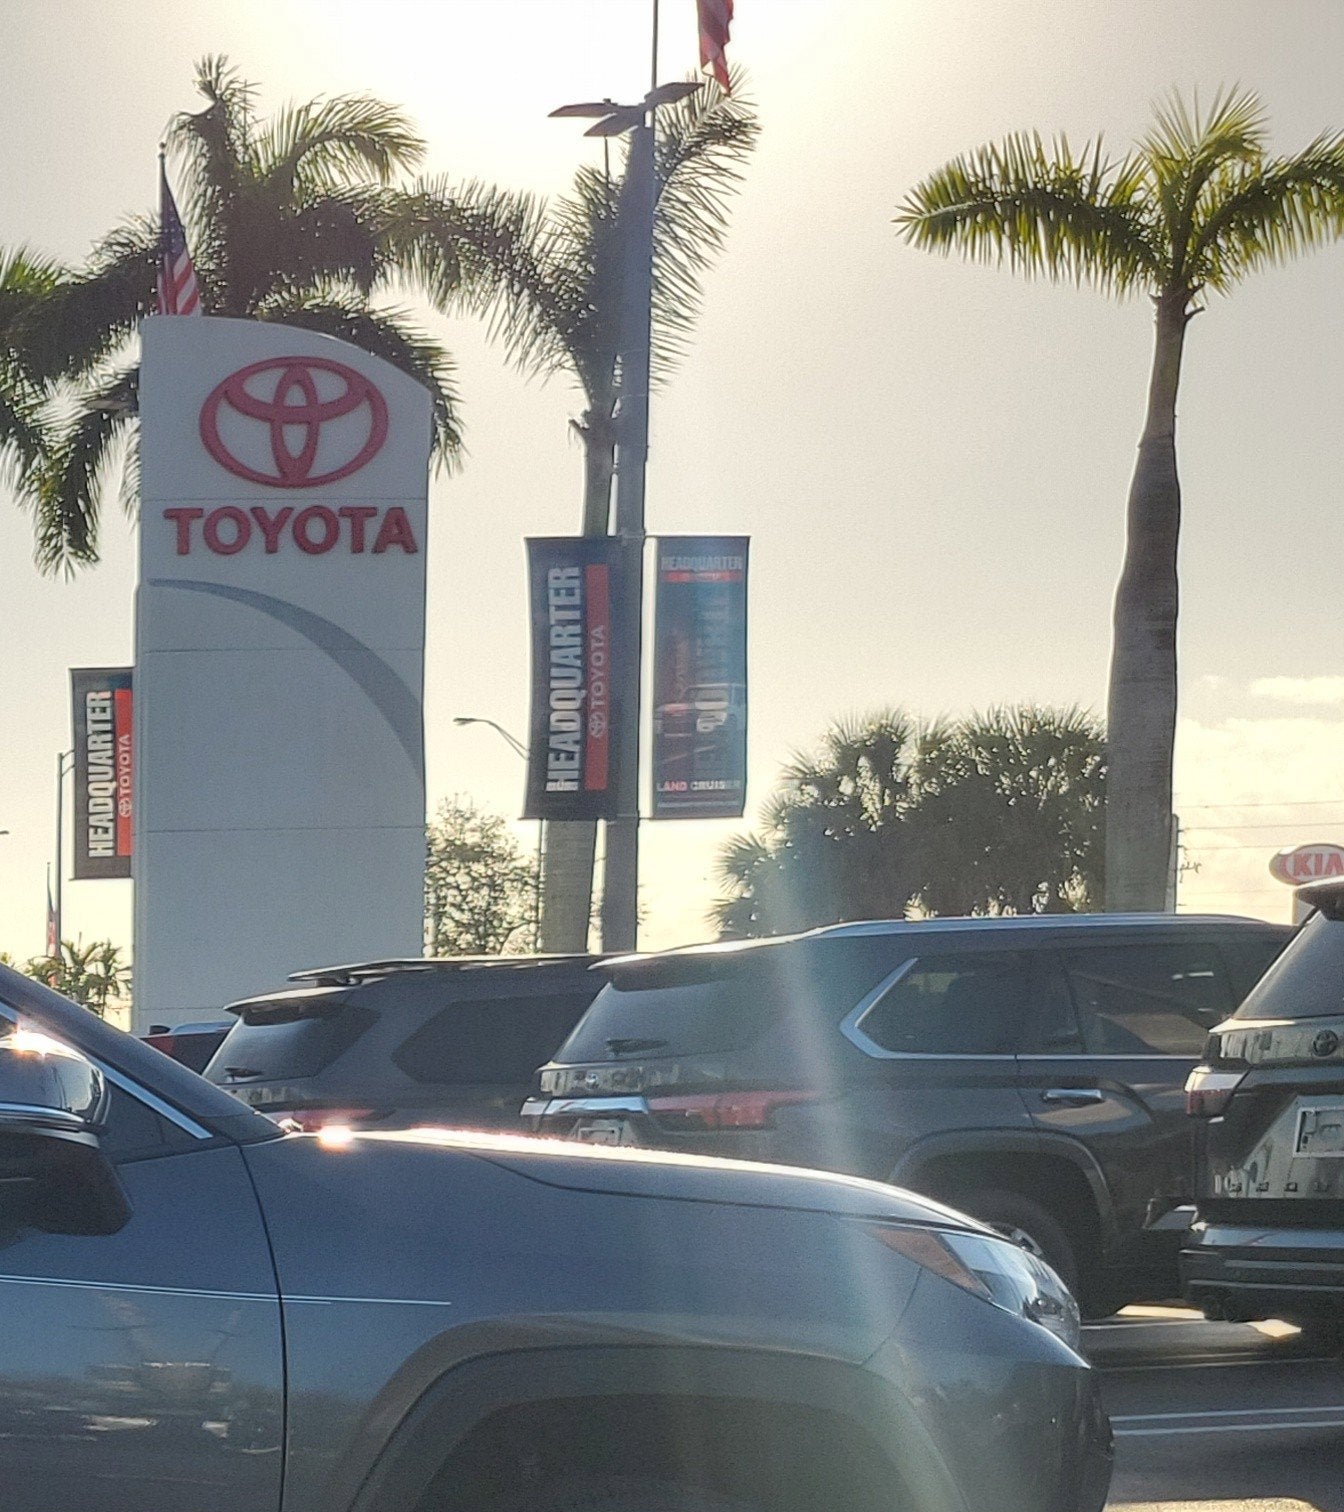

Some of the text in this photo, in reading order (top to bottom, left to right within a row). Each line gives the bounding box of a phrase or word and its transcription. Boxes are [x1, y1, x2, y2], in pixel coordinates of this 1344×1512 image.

[163, 505, 418, 555] TOYOTA
[546, 566, 586, 792] HEADQUARTER
[590, 625, 606, 709] TOYOTA
[86, 691, 116, 858] HEADQUARTER
[118, 734, 131, 799] TOYOTA
[657, 781, 687, 791] LAND
[1293, 853, 1344, 876] KIA
